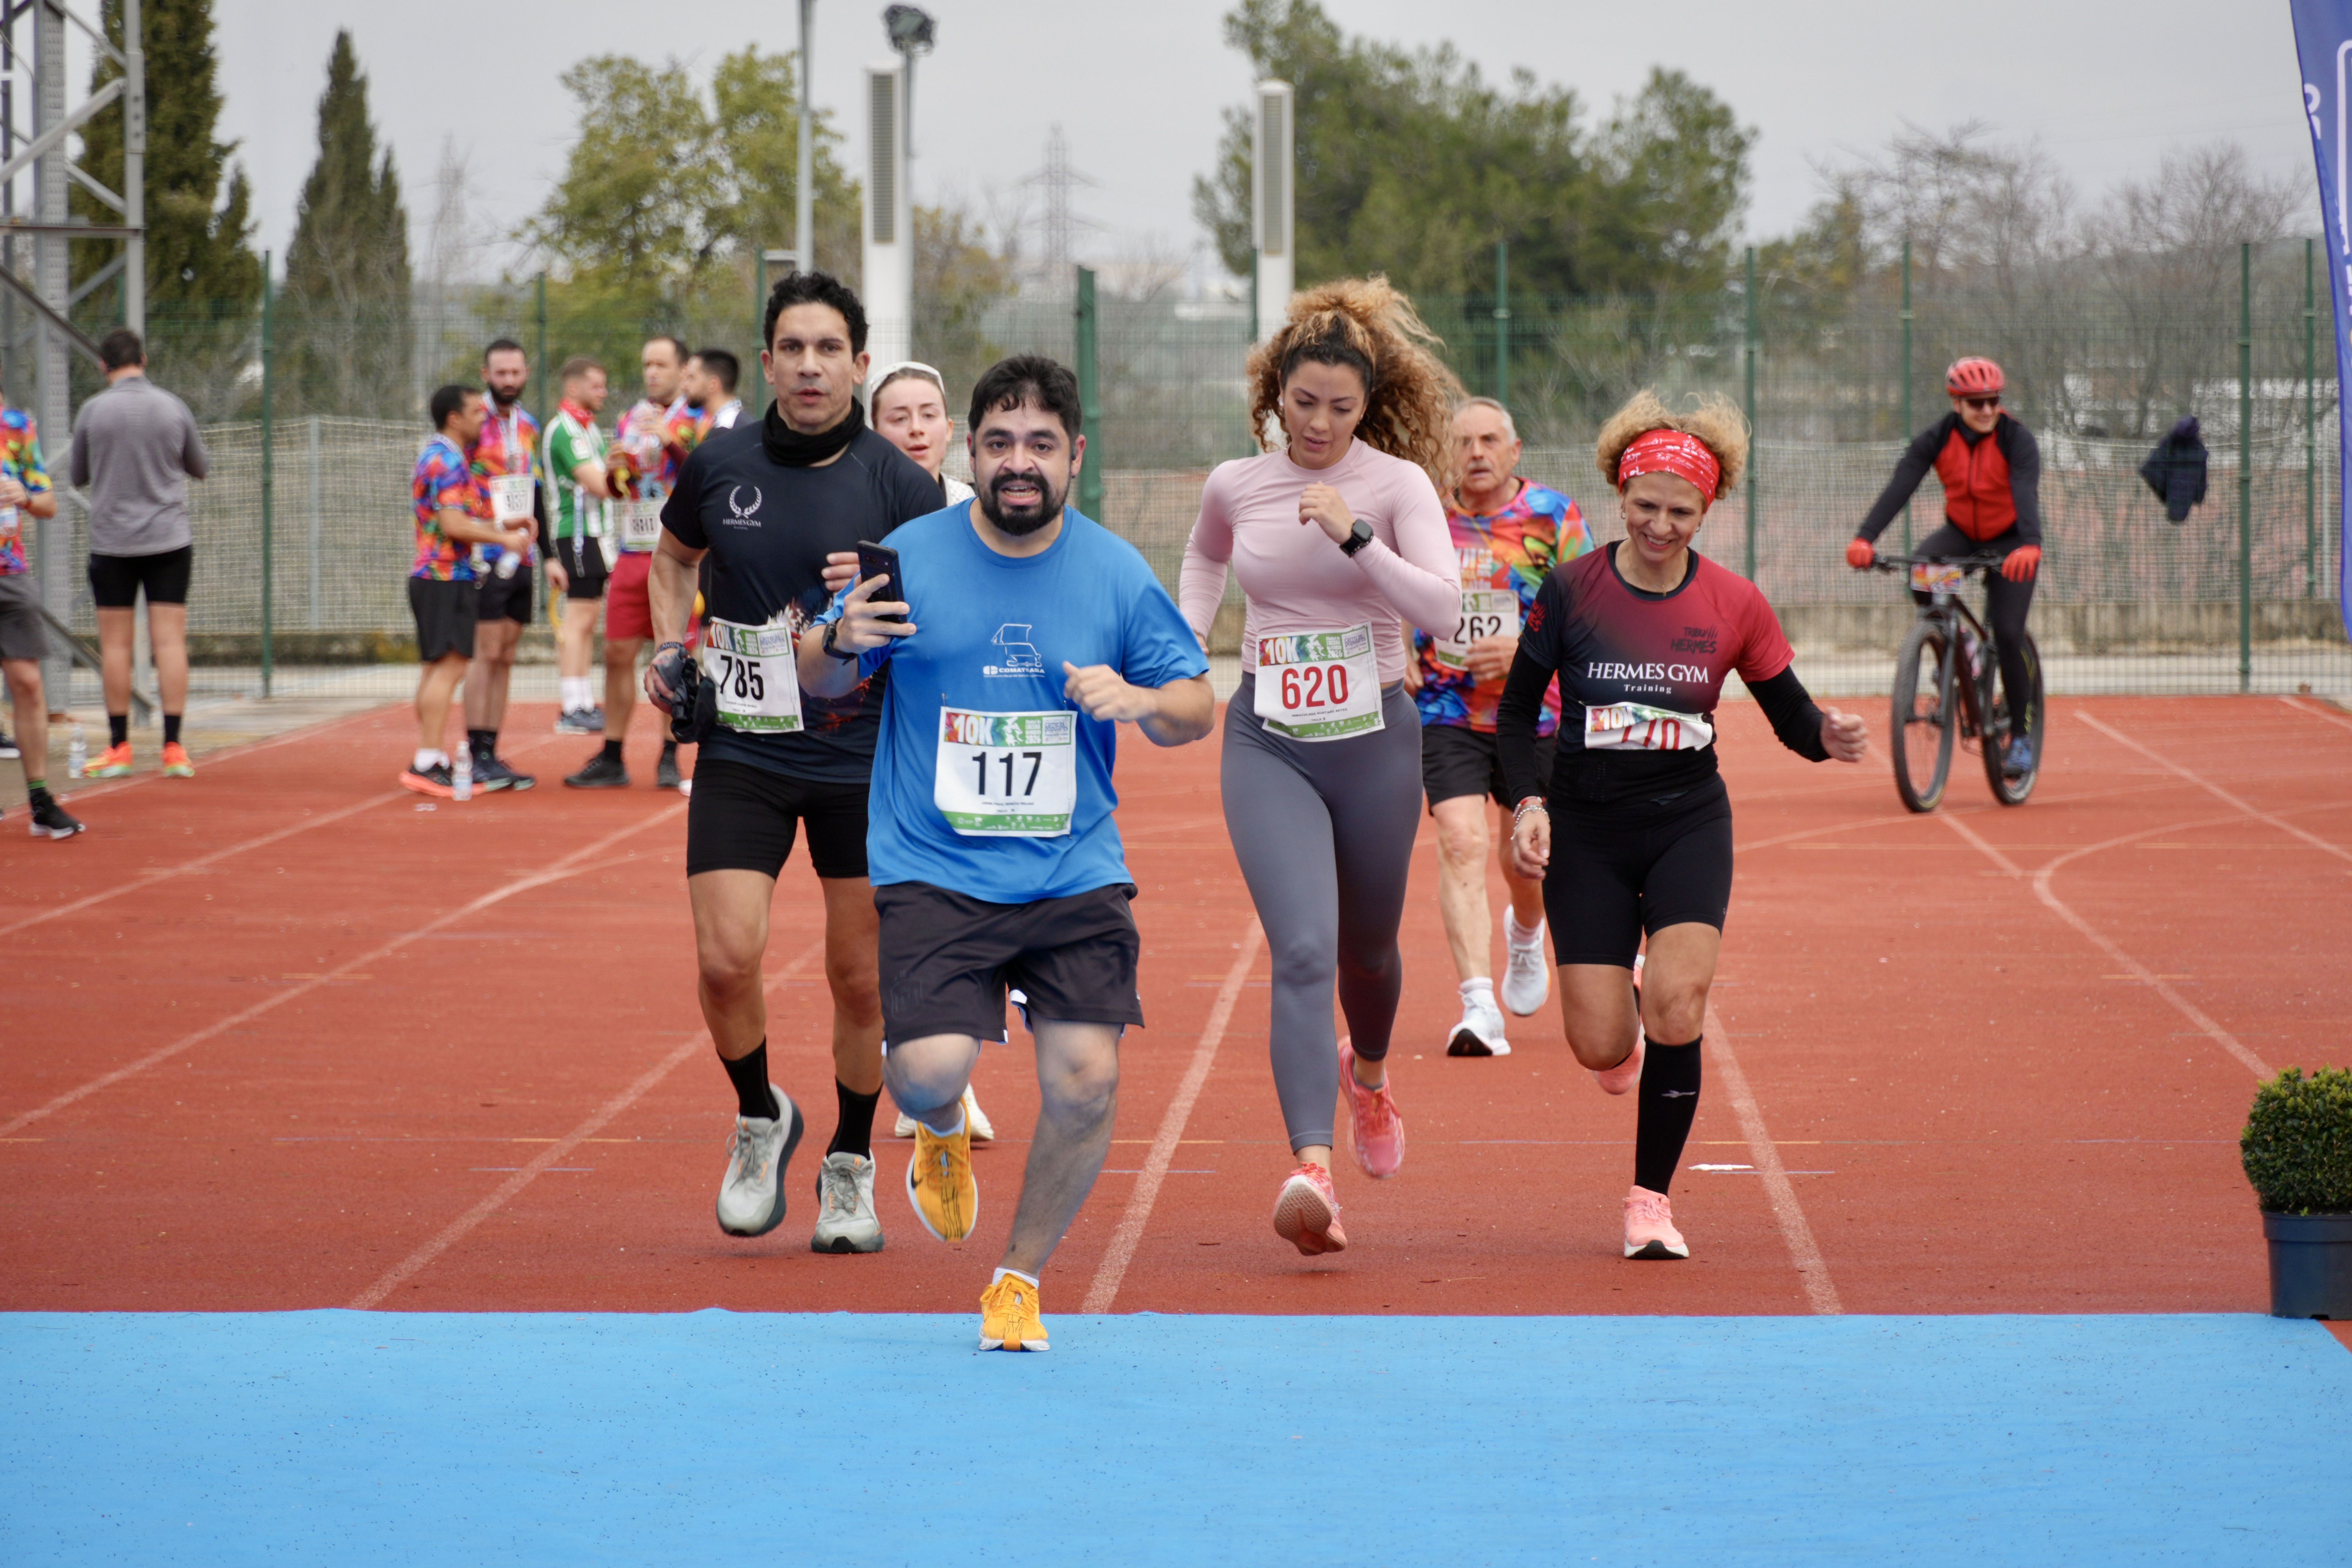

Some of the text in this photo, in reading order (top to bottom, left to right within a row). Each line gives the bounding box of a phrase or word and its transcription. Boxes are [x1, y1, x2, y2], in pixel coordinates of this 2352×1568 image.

[710, 623, 733, 650] 10K
[1671, 639, 1717, 654] HERMES
[1265, 637, 1300, 664] 10K
[720, 654, 764, 700] 785
[1587, 662, 1709, 683] HERMES GYM
[1282, 664, 1348, 709] 620
[1623, 684, 1672, 694] Training
[954, 714, 994, 745] 10K
[972, 751, 1042, 797] 117
